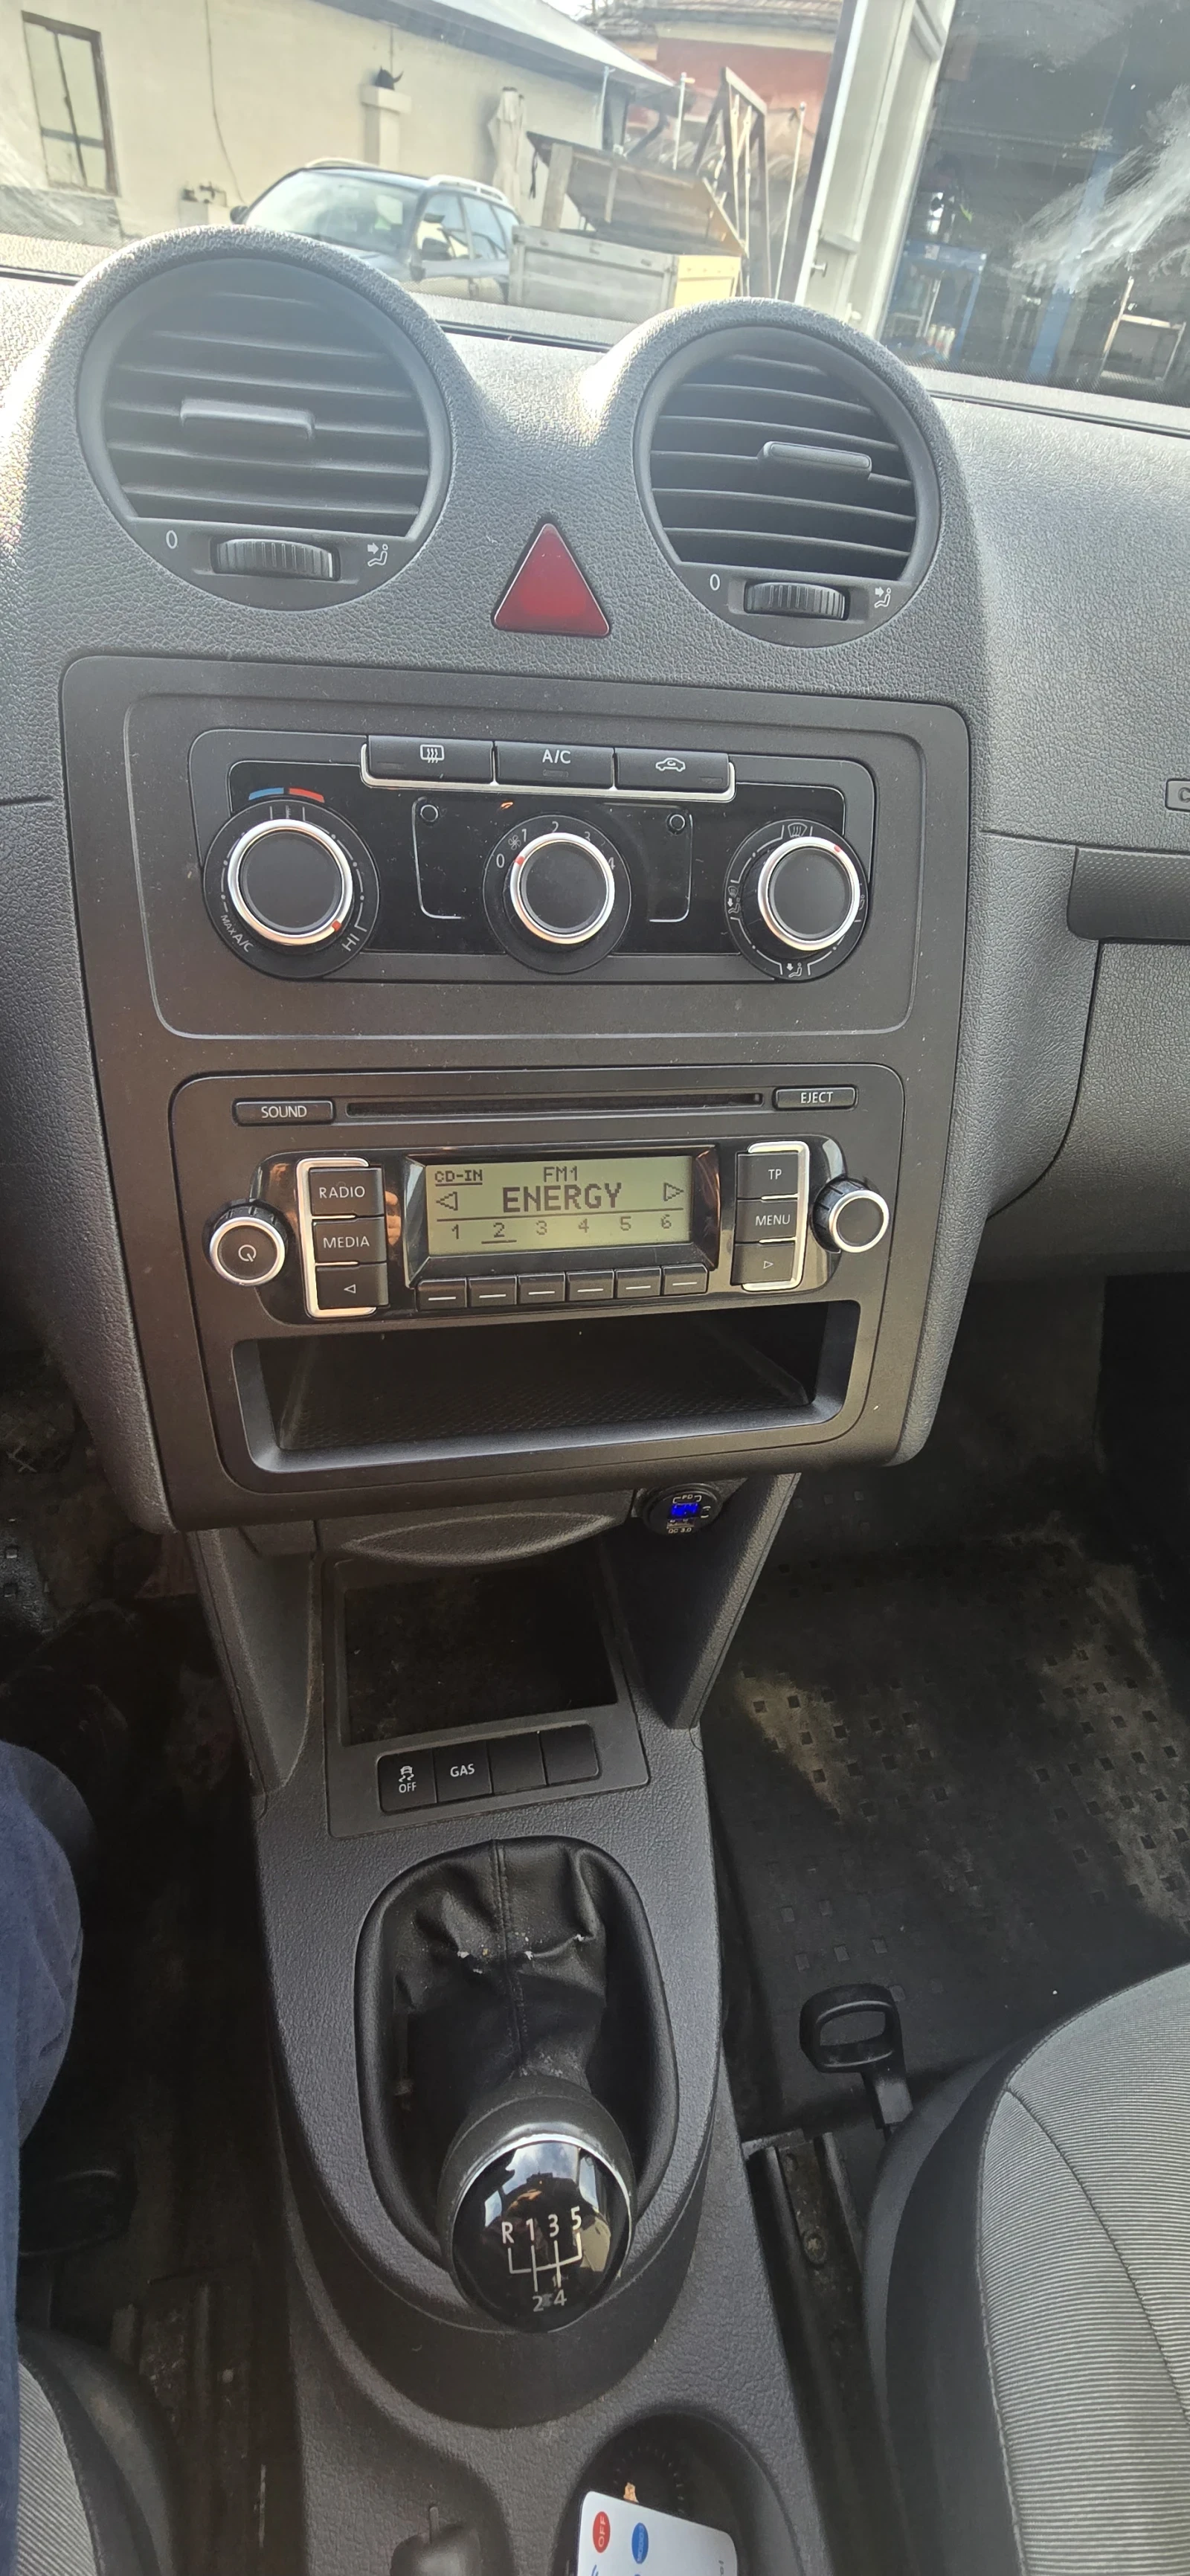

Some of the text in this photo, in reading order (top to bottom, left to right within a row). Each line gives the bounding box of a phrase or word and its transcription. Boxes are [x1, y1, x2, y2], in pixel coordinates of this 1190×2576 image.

[541, 749, 571, 765] A/C
[521, 828, 527, 843] 1
[495, 853, 506, 869] 0
[220, 915, 254, 953] MAX A/C
[341, 933, 360, 952] HI
[800, 1091, 834, 1104] EJECT
[260, 1105, 308, 1119] SOUND
[434, 1169, 483, 1183] CD-IN
[542, 1166, 579, 1183] FM1
[768, 1168, 783, 1181] TP
[318, 1185, 366, 1200] RADIO
[502, 1182, 623, 1214] ENERGY
[451, 1214, 672, 1240] 1 2 3 4 5 6
[755, 1213, 791, 1227] MENU
[322, 1235, 370, 1249] MEDIA
[450, 1764, 475, 1778] GAS
[398, 1782, 417, 1793] OFF
[501, 2206, 582, 2244] R 1 3 5
[532, 2289, 567, 2313] 2 4
[597, 2515, 606, 2548] OFF
